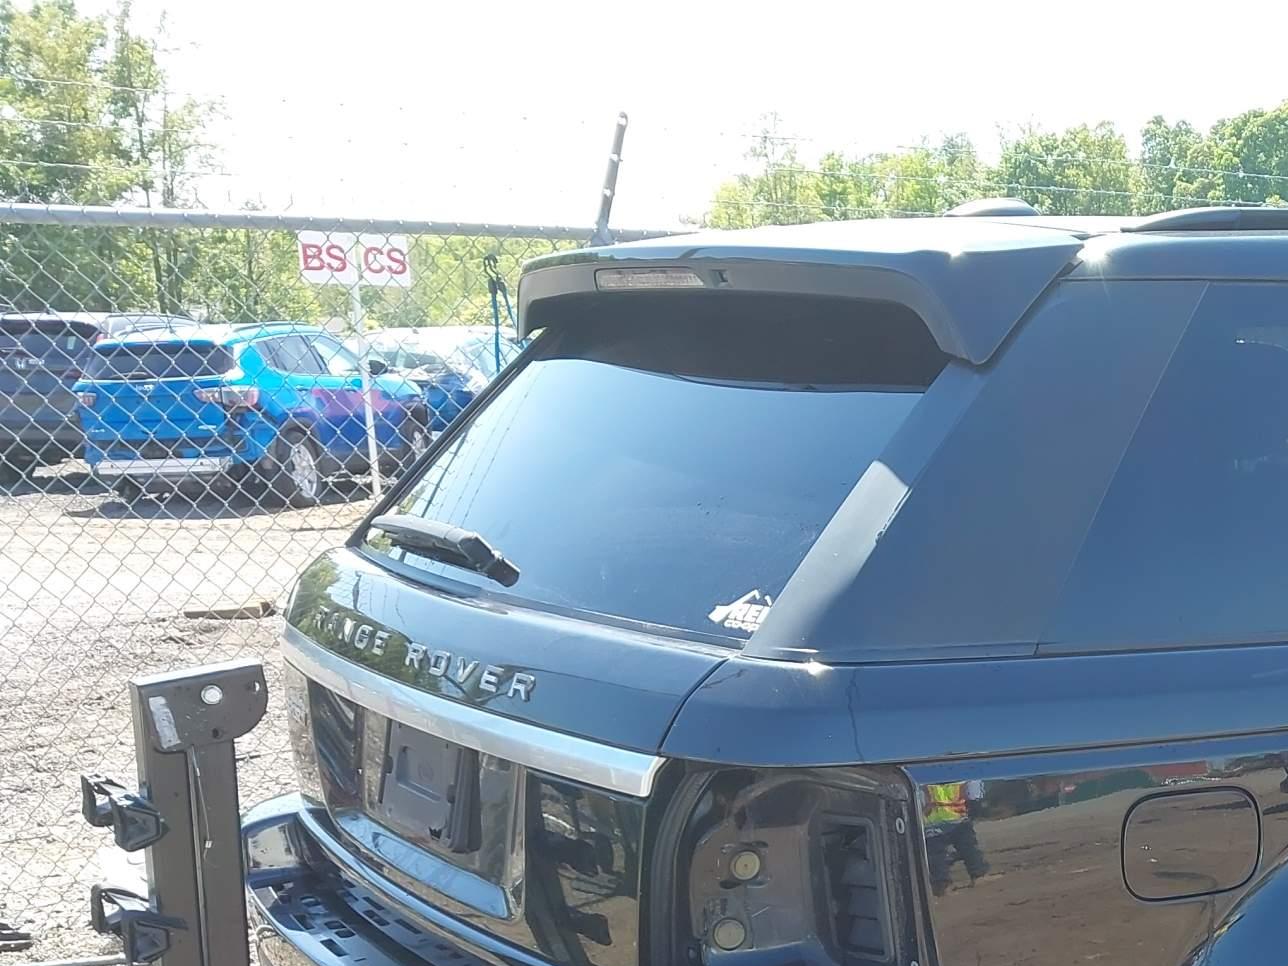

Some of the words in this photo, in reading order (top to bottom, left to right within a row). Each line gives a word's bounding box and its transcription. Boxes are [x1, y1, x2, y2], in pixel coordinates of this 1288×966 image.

[301, 243, 347, 272] BS
[363, 246, 407, 275] CS
[313, 605, 391, 656] RANGE
[404, 641, 536, 702] ROVER
